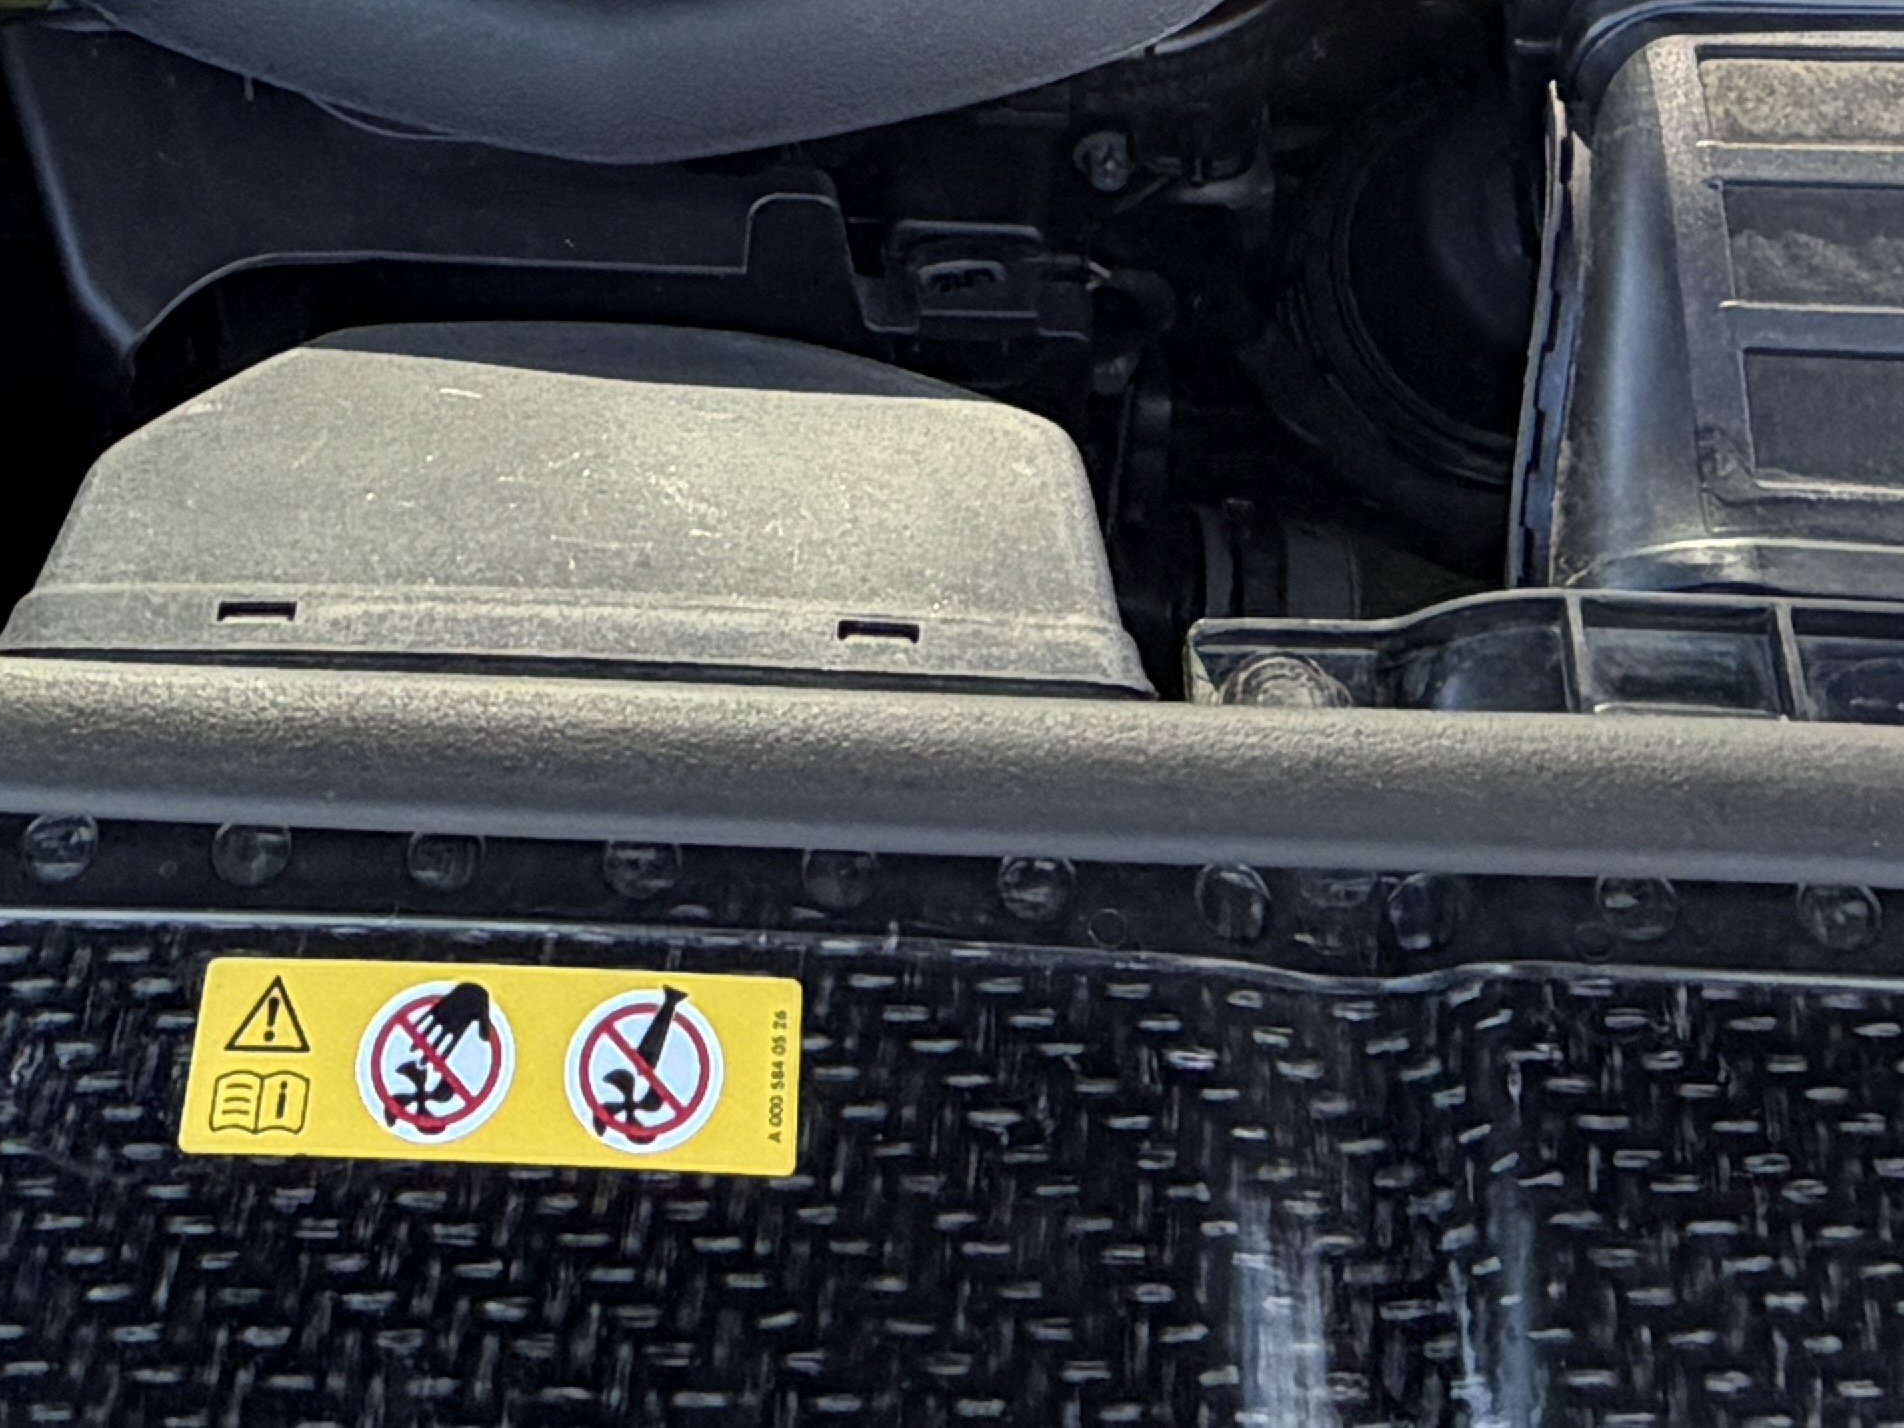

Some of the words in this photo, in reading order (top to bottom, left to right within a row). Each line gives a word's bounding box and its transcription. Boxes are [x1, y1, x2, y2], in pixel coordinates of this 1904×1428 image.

[773, 1009, 788, 1030] 26
[772, 1034, 787, 1057] 05
[770, 1060, 785, 1091] 584
[769, 1094, 783, 1127] 000
[767, 1130, 782, 1144] A
